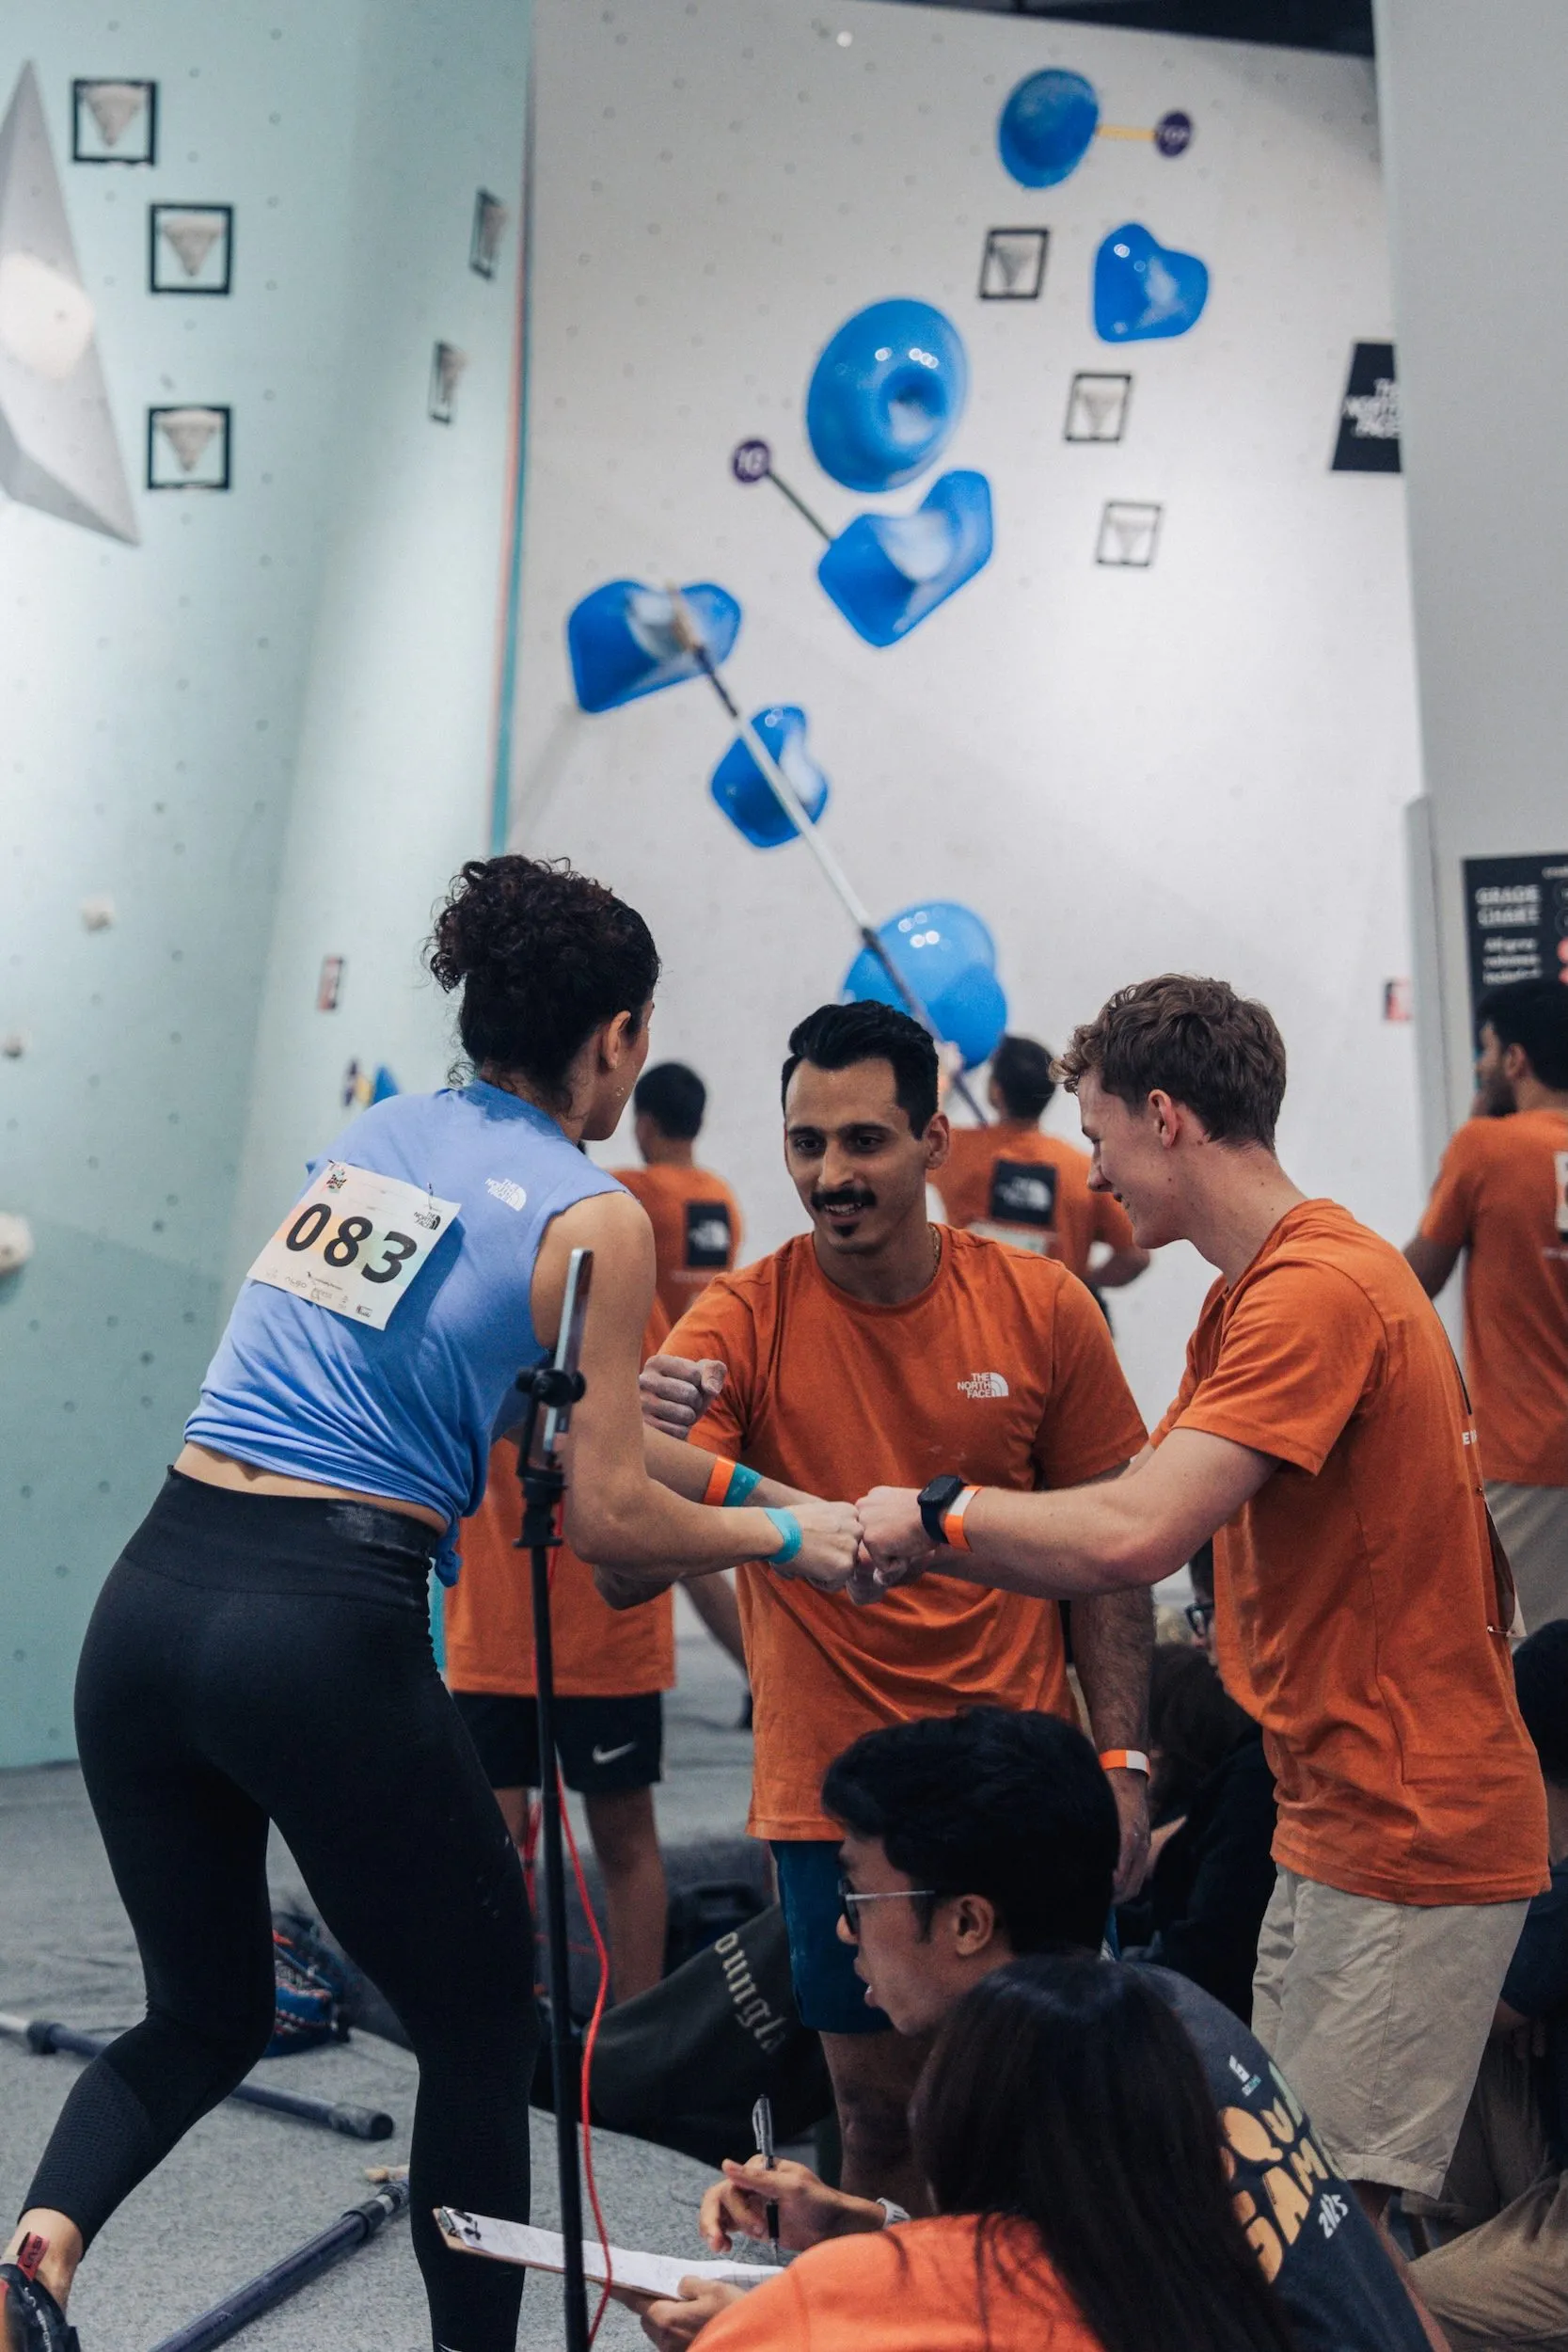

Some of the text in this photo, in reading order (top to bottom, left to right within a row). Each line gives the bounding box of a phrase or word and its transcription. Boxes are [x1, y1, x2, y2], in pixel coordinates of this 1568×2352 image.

[286, 1203, 418, 1283] 083
[971, 1373, 991, 1382] THE
[957, 1381, 991, 1391] NORTH
[967, 1389, 991, 1399] FACE
